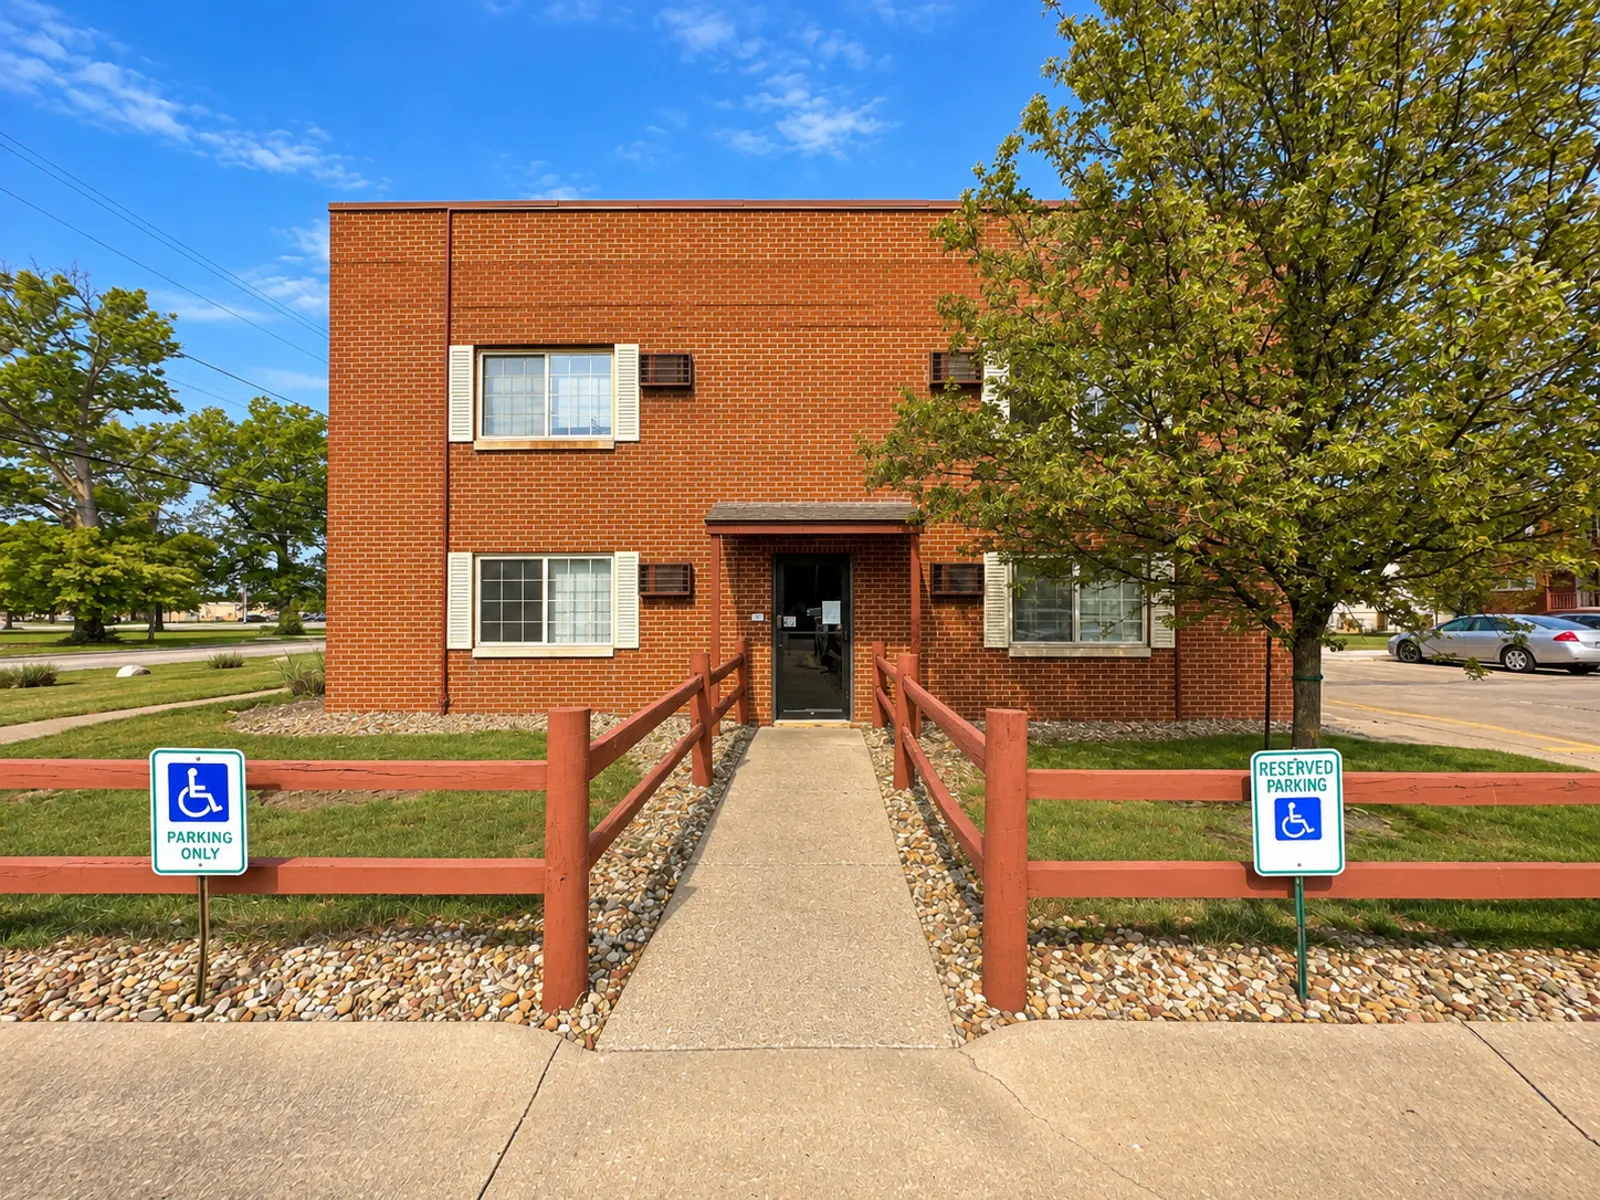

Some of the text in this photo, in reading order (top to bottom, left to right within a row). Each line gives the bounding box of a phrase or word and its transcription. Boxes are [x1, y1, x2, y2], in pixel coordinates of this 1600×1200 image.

[1259, 760, 1333, 777] RESERVED
[1267, 778, 1327, 793] PARKING
[167, 831, 233, 844] PARKING
[181, 847, 220, 860] ONLY
